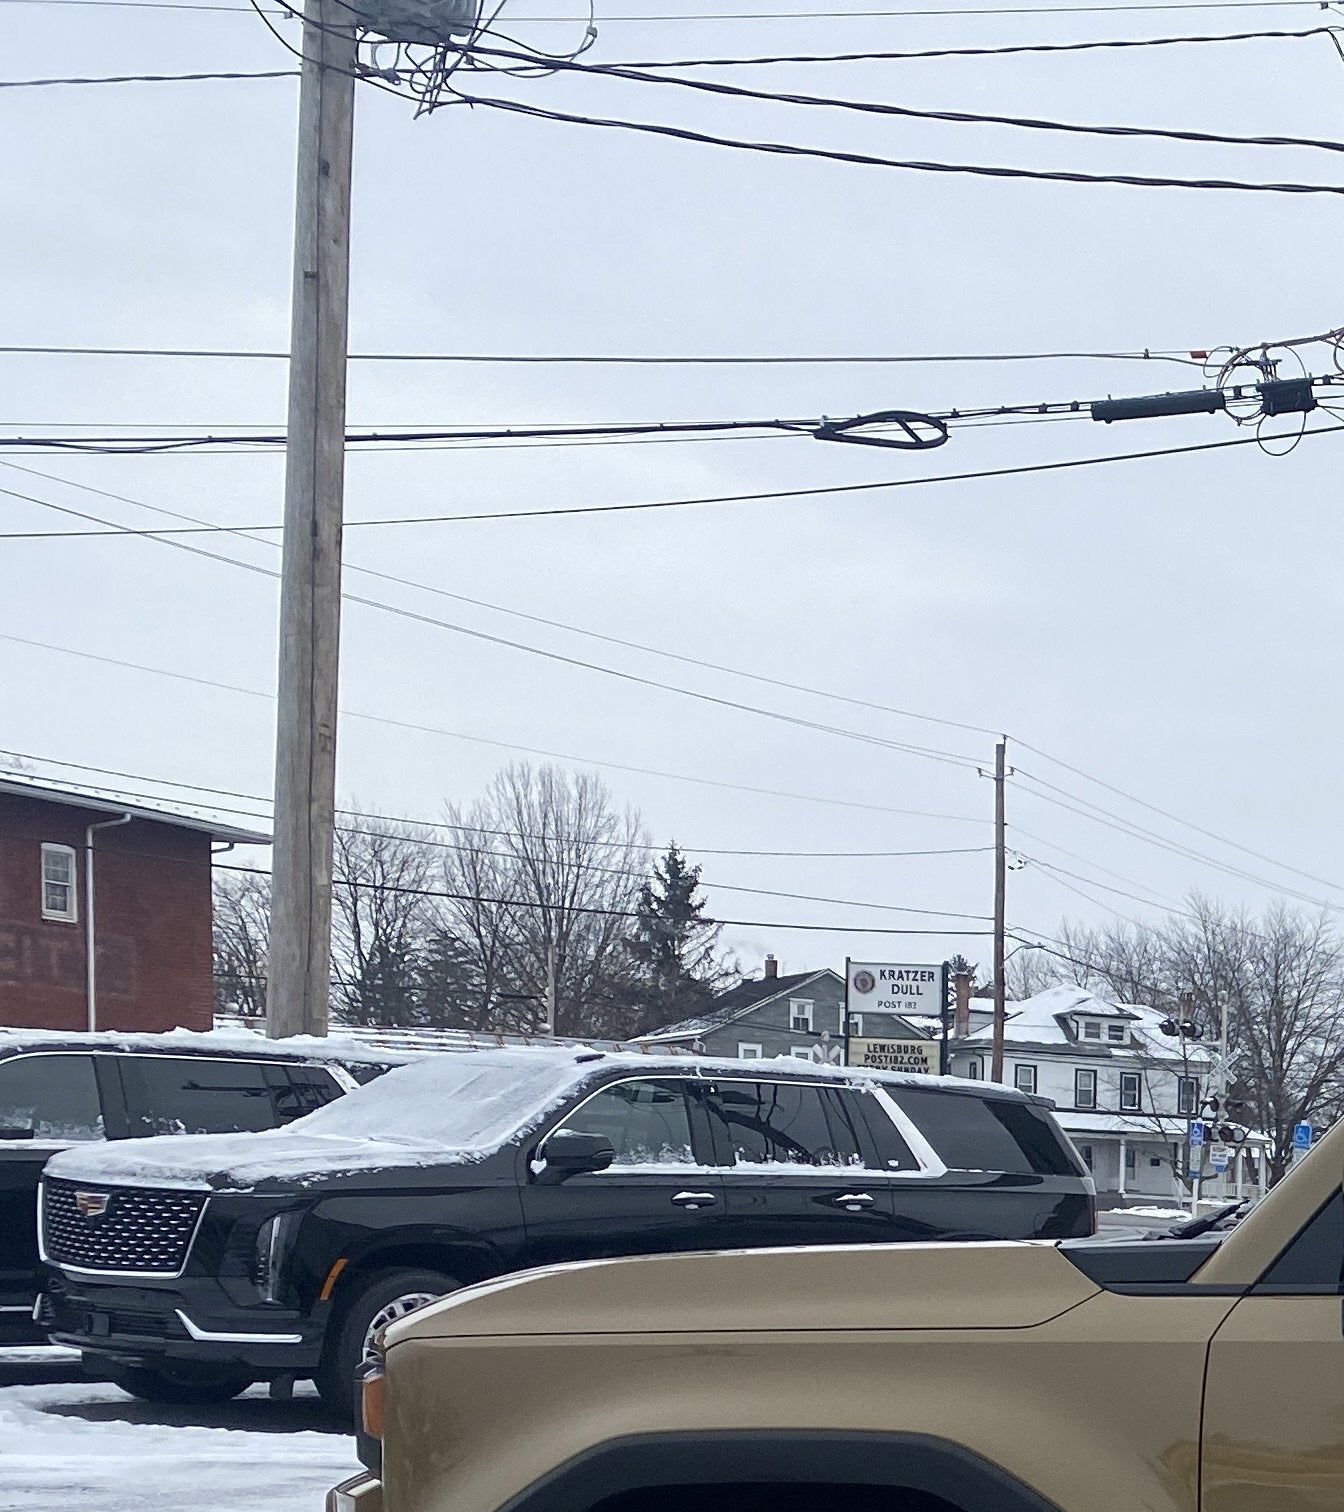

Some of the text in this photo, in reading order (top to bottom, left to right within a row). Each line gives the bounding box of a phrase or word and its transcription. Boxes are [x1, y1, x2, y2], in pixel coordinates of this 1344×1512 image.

[880, 969, 934, 982] KRATZER
[891, 984, 923, 995] DULL
[878, 1000, 901, 1009] POST
[866, 1043, 923, 1054] LEWISBURG
